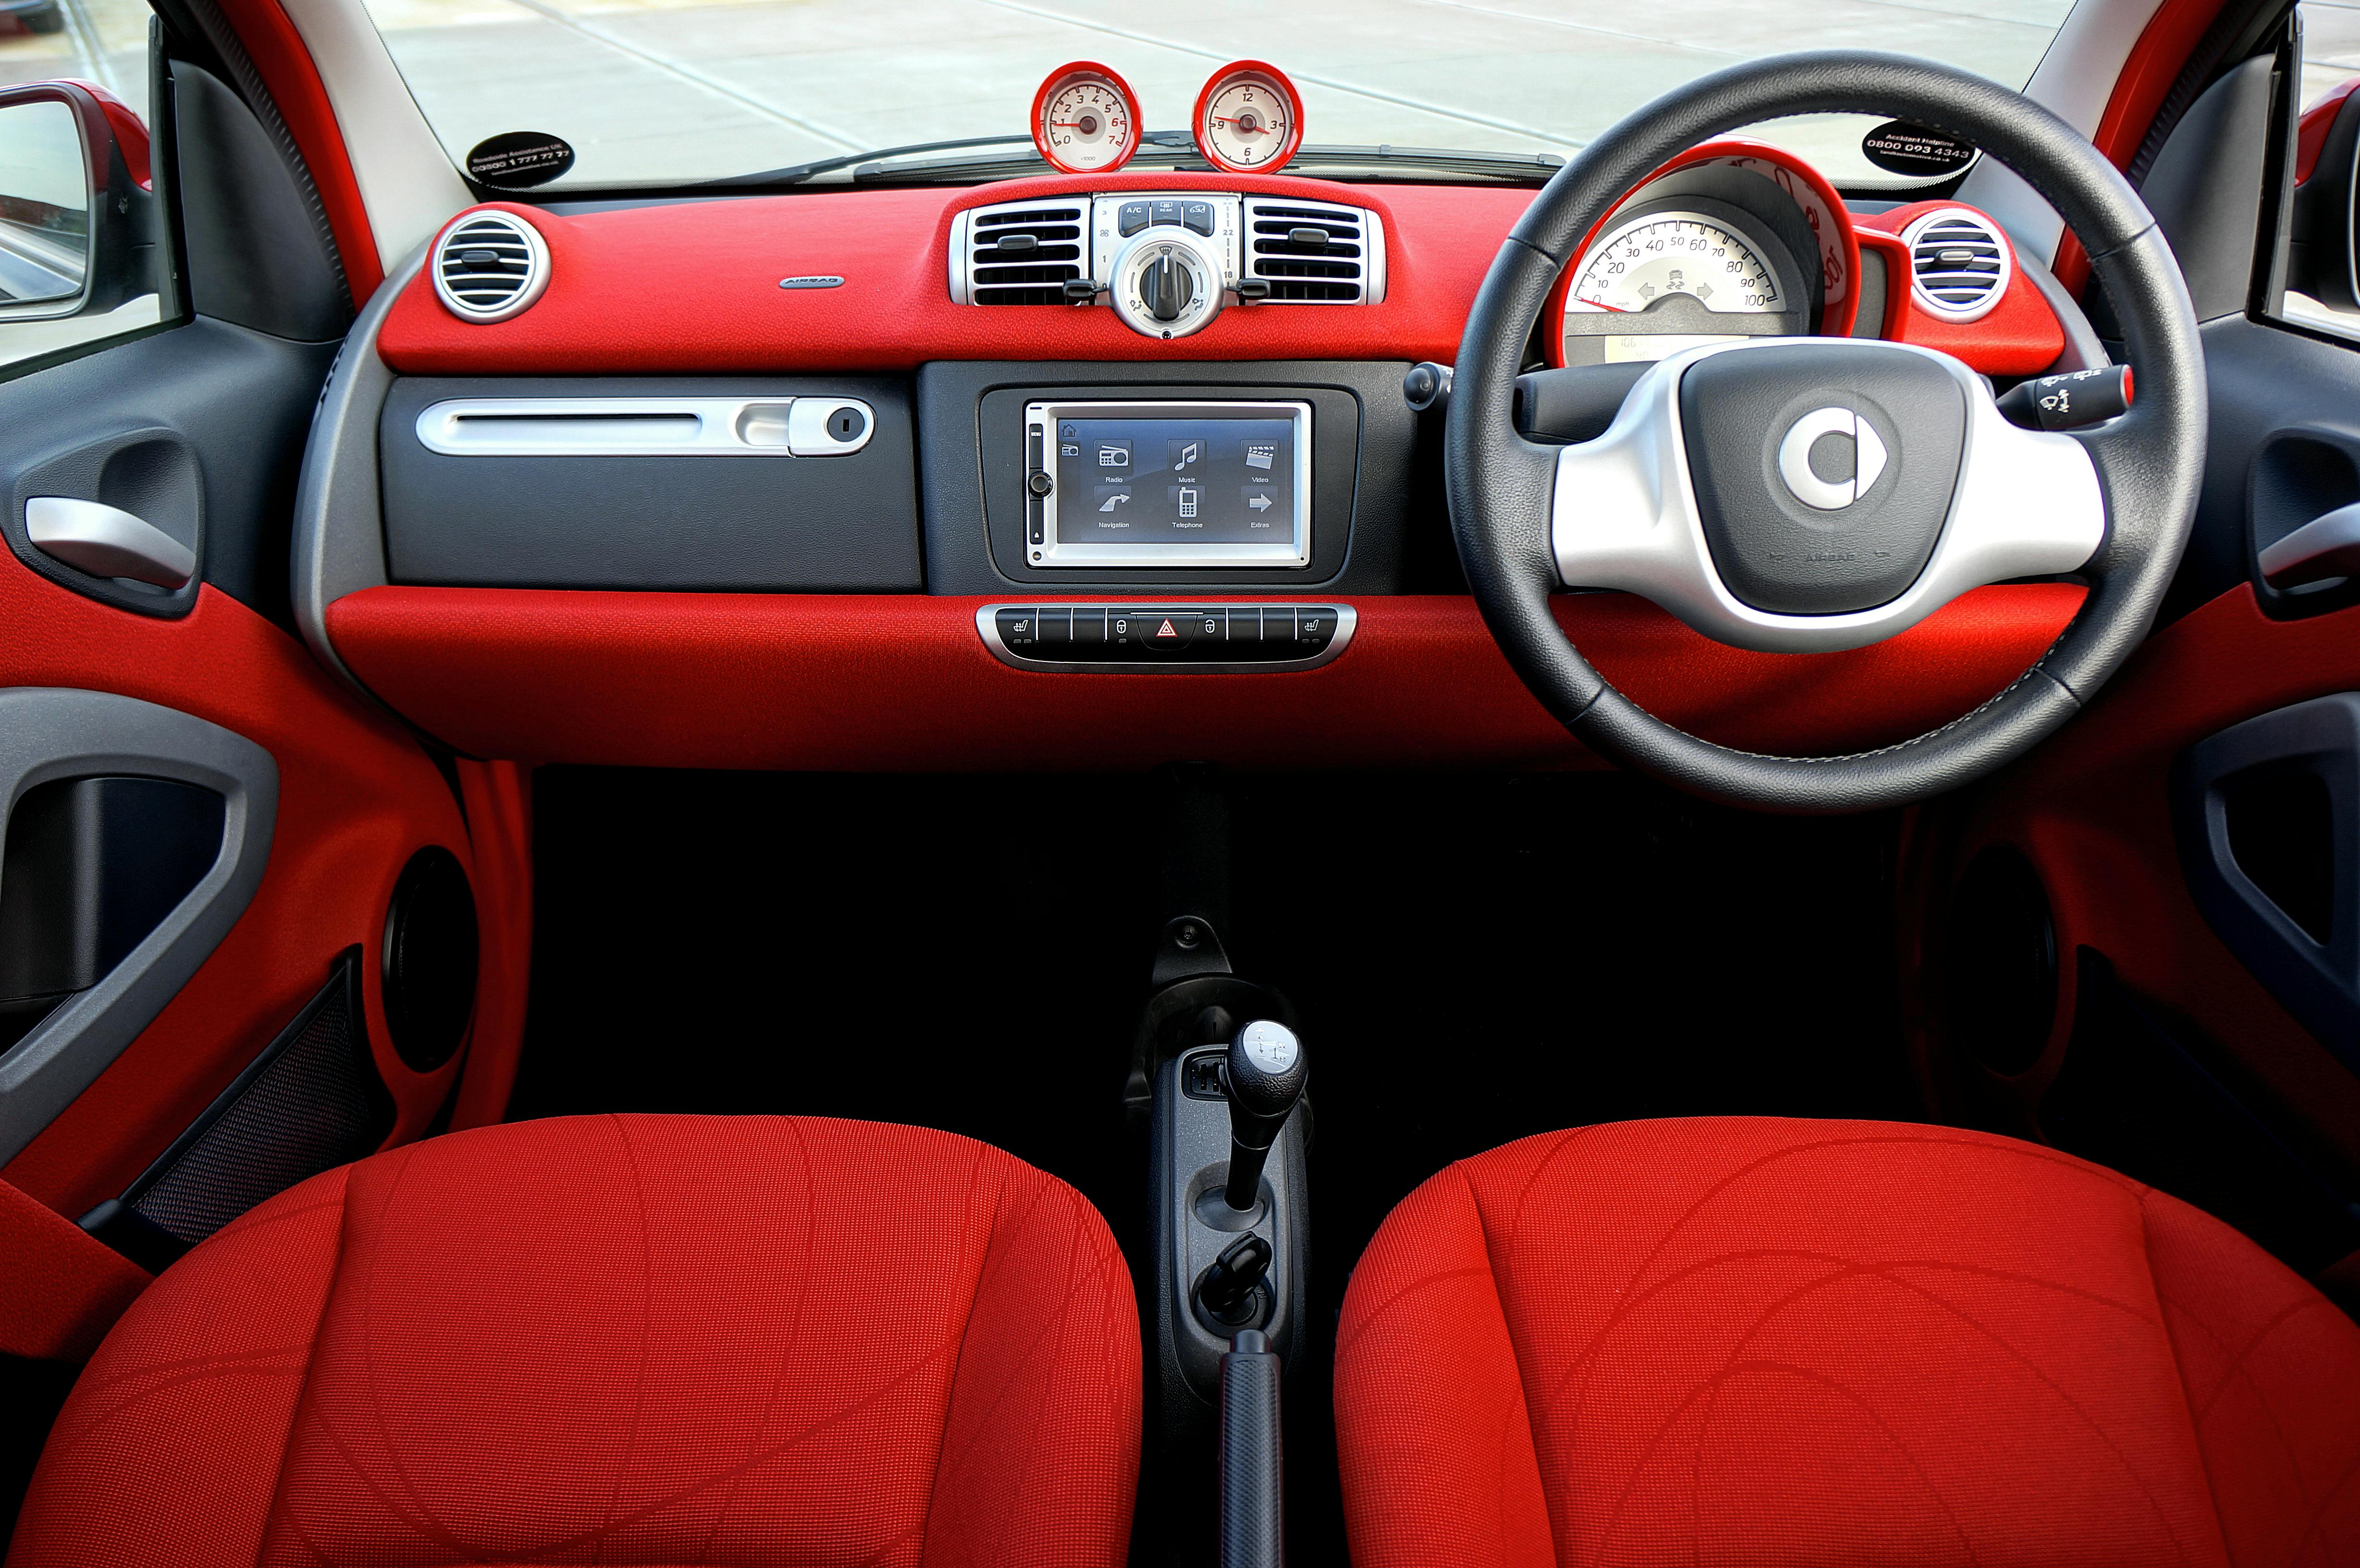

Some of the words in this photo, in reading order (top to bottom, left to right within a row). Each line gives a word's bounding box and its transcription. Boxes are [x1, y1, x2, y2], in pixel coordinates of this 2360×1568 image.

[1077, 95, 1084, 104] 3
[1092, 95, 1099, 104] 4
[1242, 93, 1253, 102] 12
[1064, 104, 1071, 113] 2
[1105, 104, 1112, 113] 5
[1111, 118, 1119, 126] 6
[1217, 121, 1224, 129] 9
[1270, 121, 1277, 129] 3
[1064, 135, 1070, 144] 0
[1109, 135, 1115, 144] 7
[1886, 134, 1920, 143] Accident
[1922, 138, 1954, 147] Helpline
[1244, 147, 1251, 156] 6
[1867, 139, 1901, 150] 0800
[1905, 144, 1930, 153] 093
[1934, 147, 1969, 159] 4343
[473, 153, 508, 164] Roadside
[509, 146, 549, 157] Assistance
[472, 161, 506, 172] 00800
[517, 155, 538, 164] 777
[1646, 240, 1664, 251] 40
[1670, 237, 1684, 246] 50
[1689, 239, 1707, 251] 60
[1626, 248, 1640, 257] 30
[1712, 248, 1725, 257] 70
[1608, 262, 1625, 274] 20
[1726, 261, 1743, 273] 80
[1598, 280, 1609, 288] 10
[1740, 279, 1755, 288] 90
[1745, 295, 1765, 306] 100
